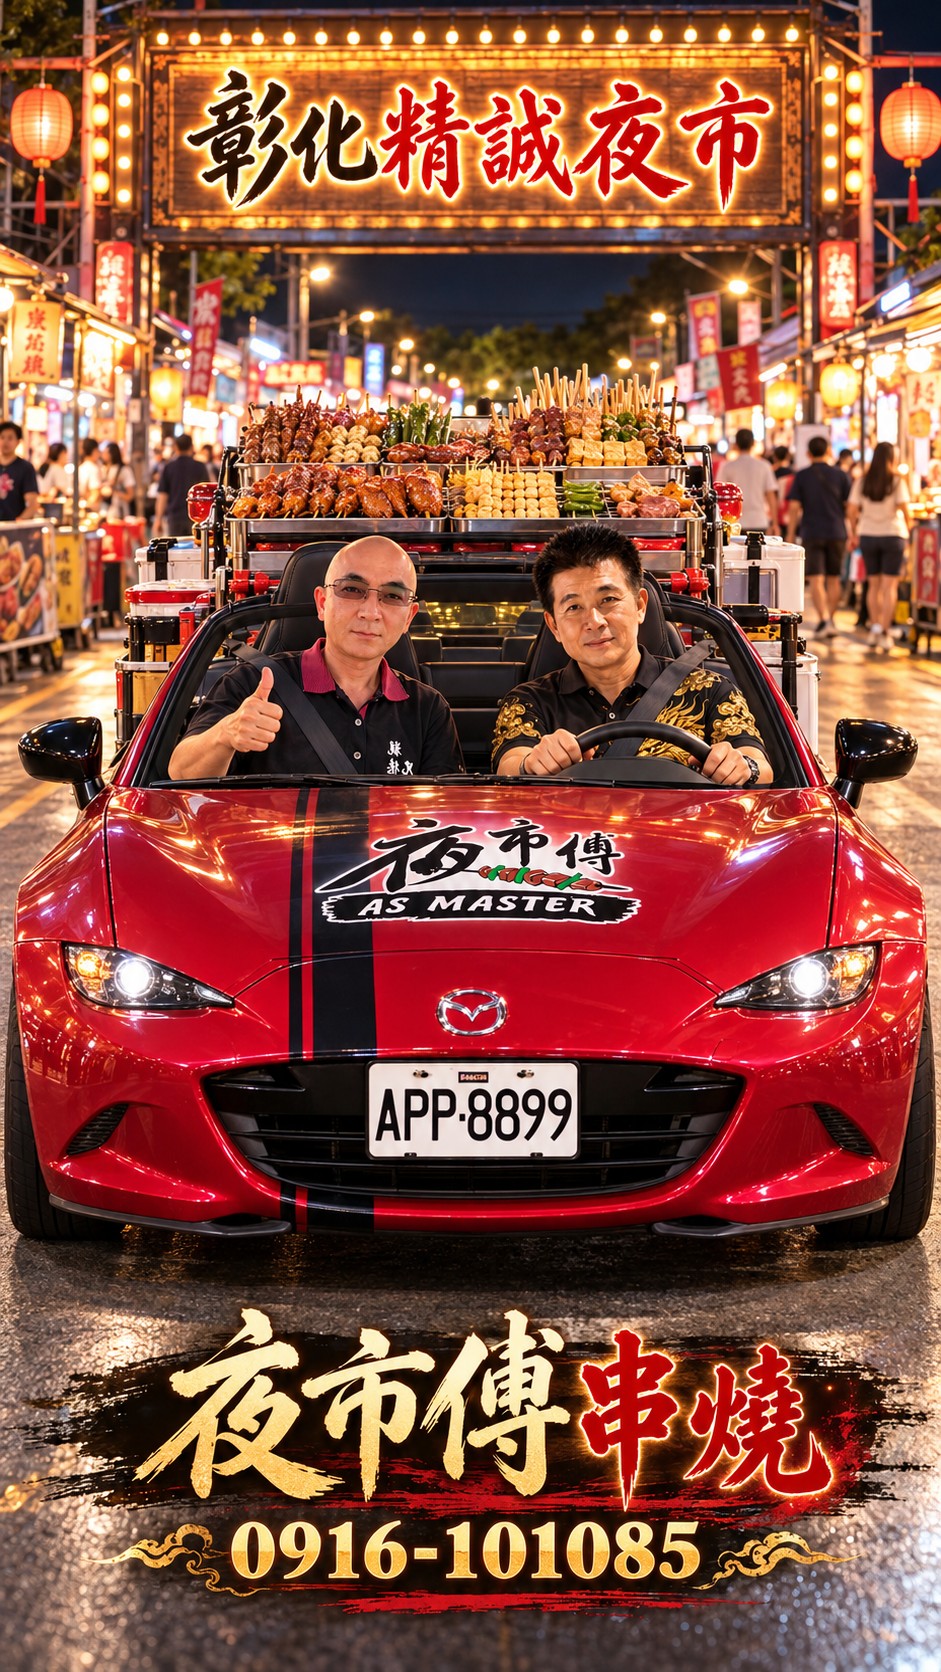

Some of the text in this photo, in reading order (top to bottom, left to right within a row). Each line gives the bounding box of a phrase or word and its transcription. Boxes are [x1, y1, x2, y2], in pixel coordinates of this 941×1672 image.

[187, 70, 771, 210] 彰化精誠夜市
[357, 895, 595, 917] AS MASTER
